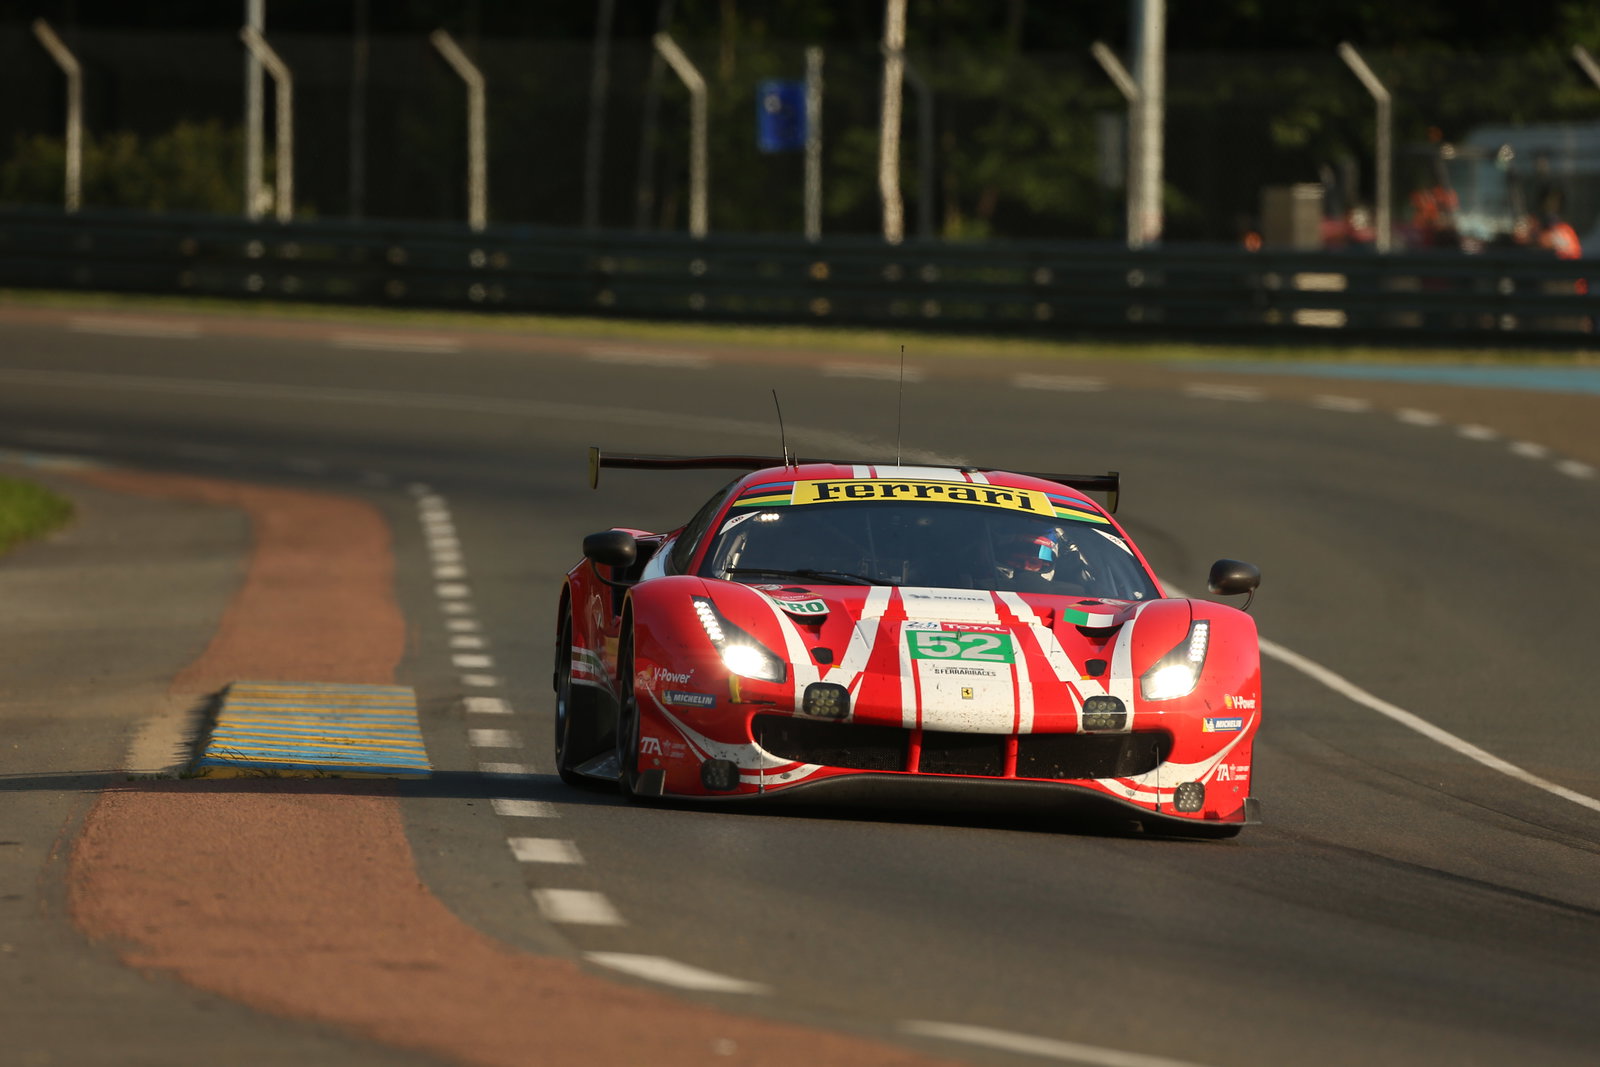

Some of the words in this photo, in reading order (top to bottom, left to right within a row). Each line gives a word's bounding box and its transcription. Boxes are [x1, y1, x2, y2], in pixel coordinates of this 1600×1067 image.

[812, 482, 1035, 510] Ferrari
[944, 623, 1007, 632] TOTAL
[916, 632, 1004, 660] 52
[654, 667, 691, 684] V-Power
[673, 694, 713, 705] MICHELIN
[1215, 720, 1242, 728] MICHELIN
